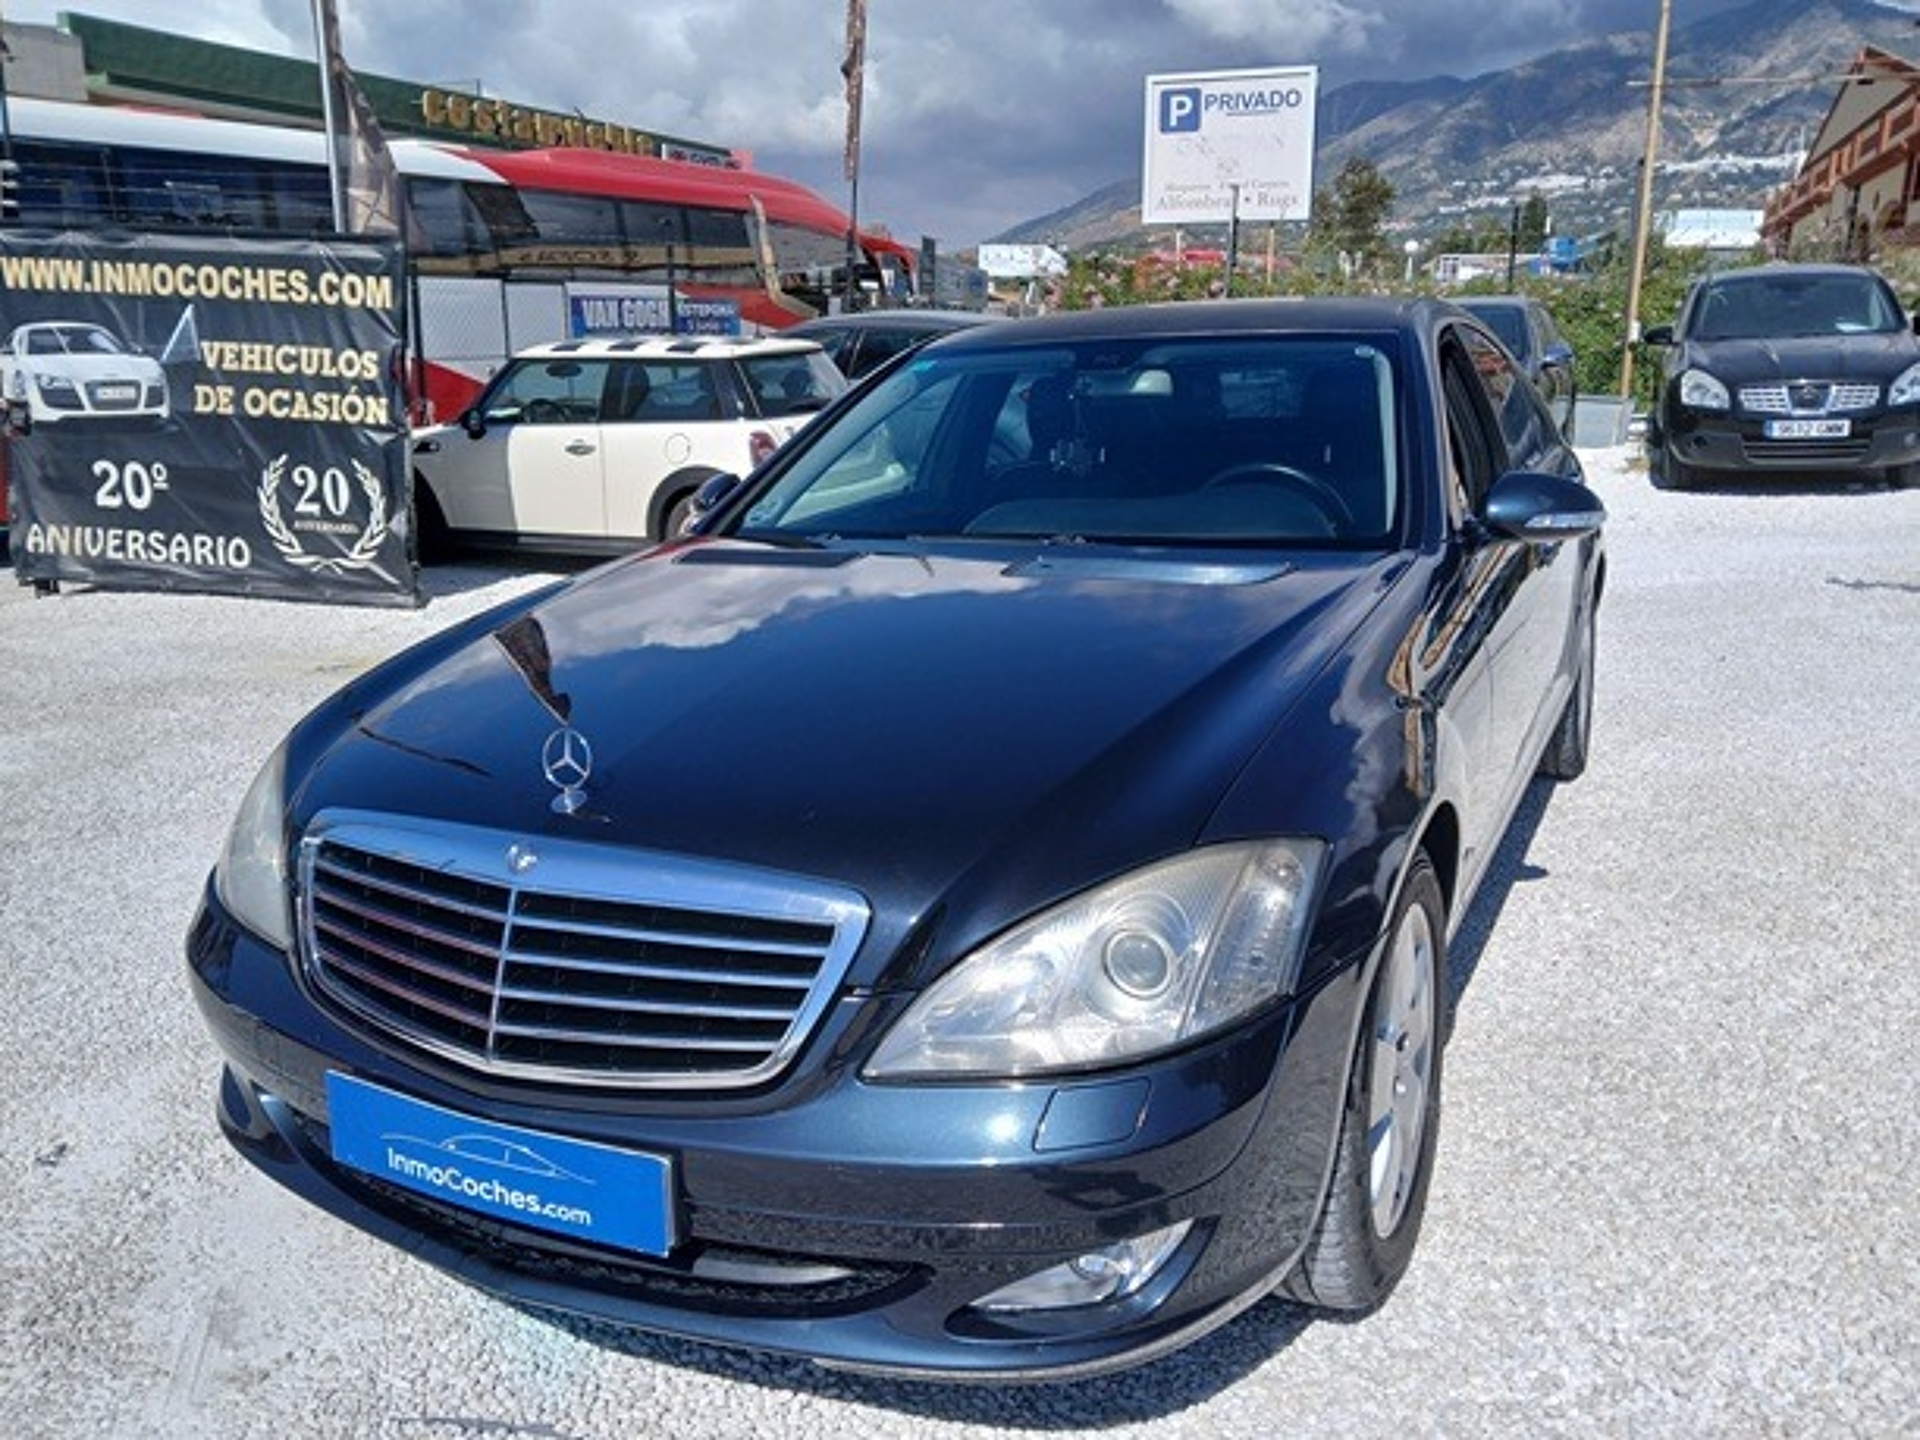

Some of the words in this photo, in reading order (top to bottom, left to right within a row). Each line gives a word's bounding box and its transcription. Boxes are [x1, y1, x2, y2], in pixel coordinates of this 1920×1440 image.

[1169, 96, 1193, 127] P
[1204, 89, 1303, 111] PRIVADO
[0, 255, 392, 309] WWW.INMOCOCHES.COM
[582, 299, 619, 327] VAN
[620, 301, 669, 328] GOGH
[200, 340, 379, 379] VEHICULOS
[194, 385, 235, 415] DE
[243, 385, 390, 425] OCASIÓN
[291, 466, 350, 517] 20
[25, 523, 251, 569] ANIVERSARIO
[387, 1147, 592, 1226] InmoCoches.com
